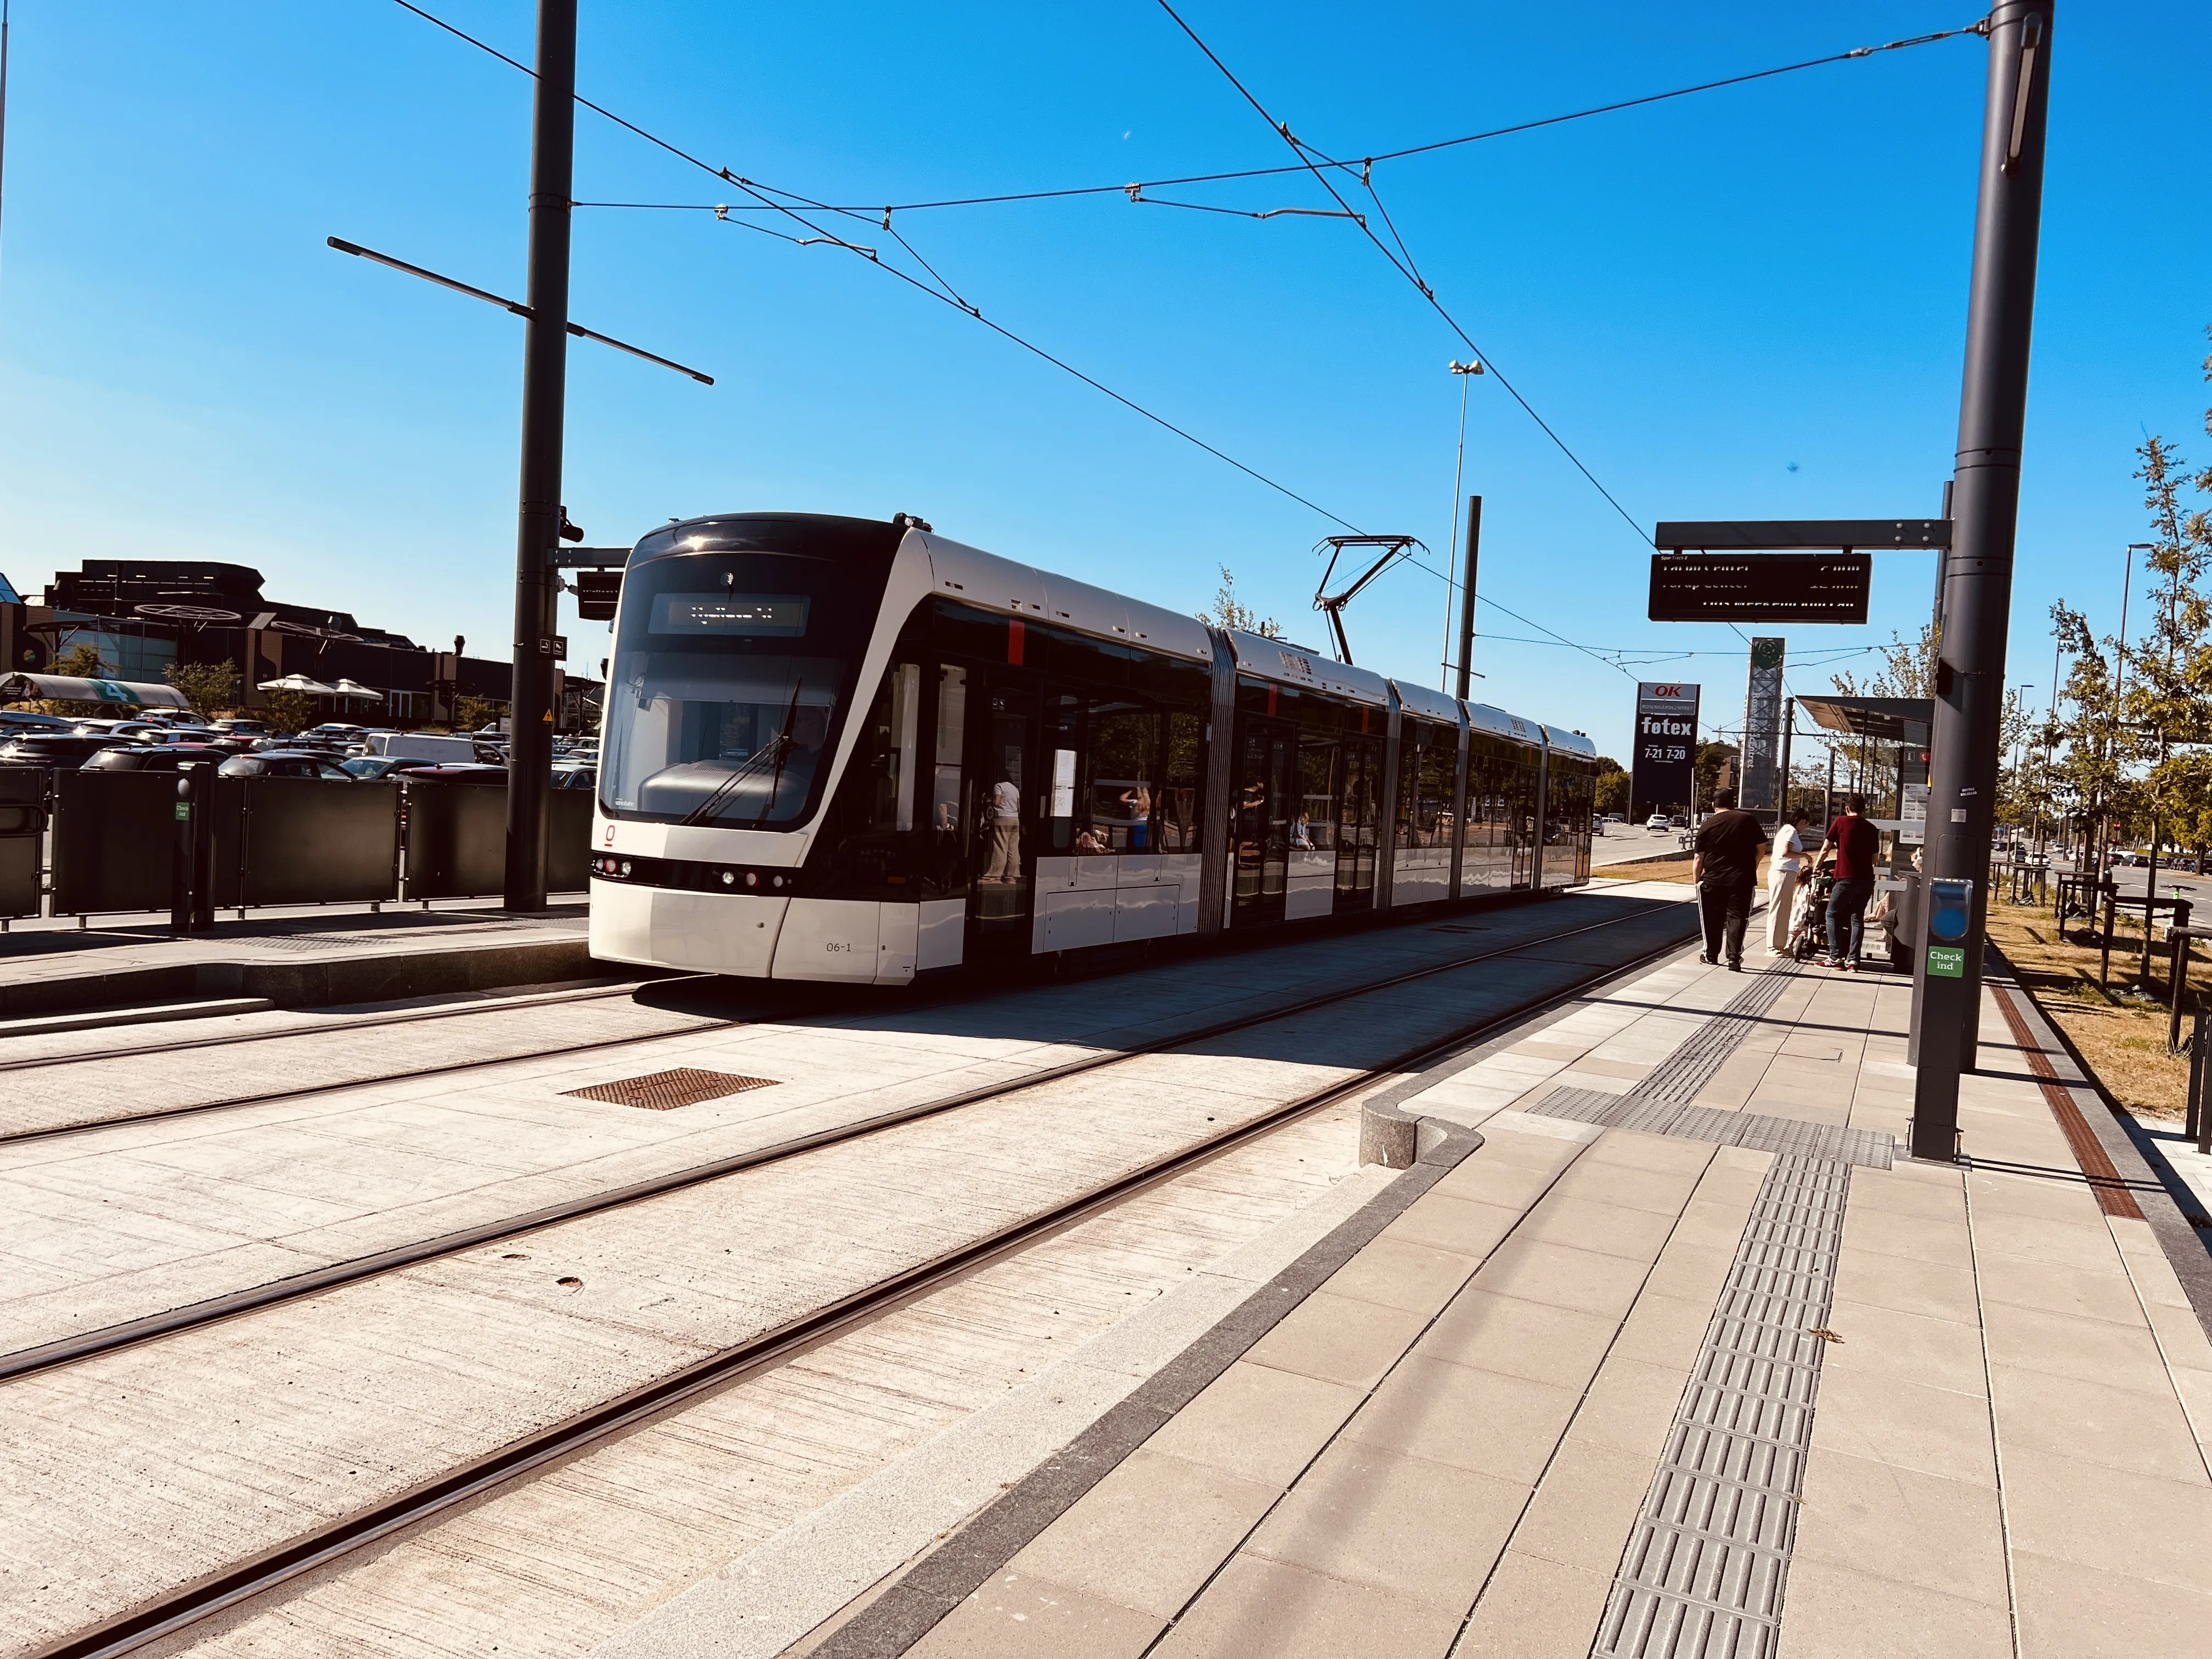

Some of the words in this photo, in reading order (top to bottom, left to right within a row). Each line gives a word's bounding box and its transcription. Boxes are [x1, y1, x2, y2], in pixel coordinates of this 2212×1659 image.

[106, 683, 128, 701] 4
[1655, 685, 1682, 697] OK
[1641, 716, 1692, 736] føtex
[1645, 748, 1662, 759] 7-21
[1666, 749, 1685, 760] 7-20
[827, 943, 851, 952] 06-1
[1930, 951, 1962, 962] Check
[1937, 961, 1954, 970] ind
